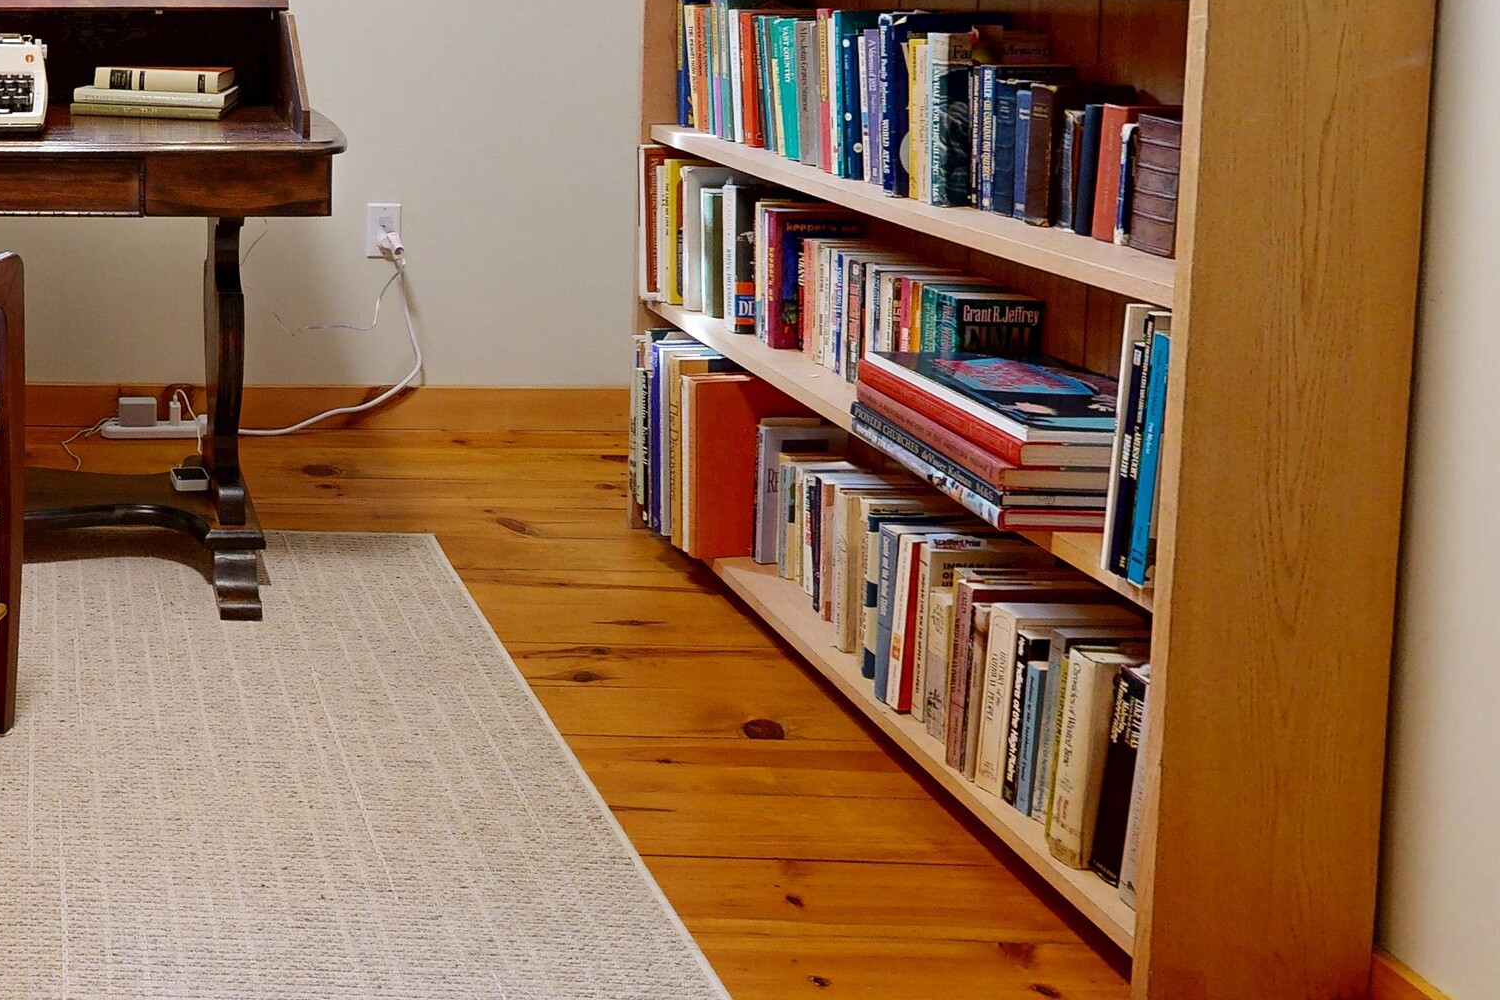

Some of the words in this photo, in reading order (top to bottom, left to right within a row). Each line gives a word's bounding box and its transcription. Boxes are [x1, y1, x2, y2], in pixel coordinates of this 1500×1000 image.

[782, 26, 790, 46] VAST
[880, 26, 888, 56] Hammond
[800, 44, 808, 61] John
[868, 46, 876, 69] Veteran
[782, 46, 791, 84] COUNTRY
[879, 58, 888, 80] Family
[932, 76, 940, 106] WHALE
[983, 69, 992, 98] RICHLER
[932, 107, 940, 122] FOR
[983, 100, 992, 110] OH
[882, 119, 890, 147] WORLD
[932, 123, 940, 140] THE
[982, 141, 991, 152] OH
[882, 150, 890, 174] ATLAS
[932, 142, 940, 176] KILLING
[963, 304, 992, 323] Grant
[993, 305, 1002, 323] R.
[1002, 305, 1040, 326] Jeffrey
[670, 400, 679, 426] The
[854, 406, 882, 430] PIONEER
[883, 422, 920, 454] CHURCHES
[670, 427, 678, 502] Discoverers
[1017, 636, 1026, 656] Hyde
[1013, 661, 1025, 698] Indians
[1070, 662, 1082, 704] Chronicles
[1012, 698, 1022, 711] of
[1068, 706, 1078, 715] of
[1132, 699, 1144, 721] LIKE
[1010, 711, 1021, 728] the
[1130, 722, 1143, 730] IT
[1008, 729, 1019, 754] High
[1066, 716, 1077, 747] Wasted
[1129, 731, 1142, 749] WAS
[1006, 754, 1017, 782] Plains
[1063, 748, 1074, 768] Time
